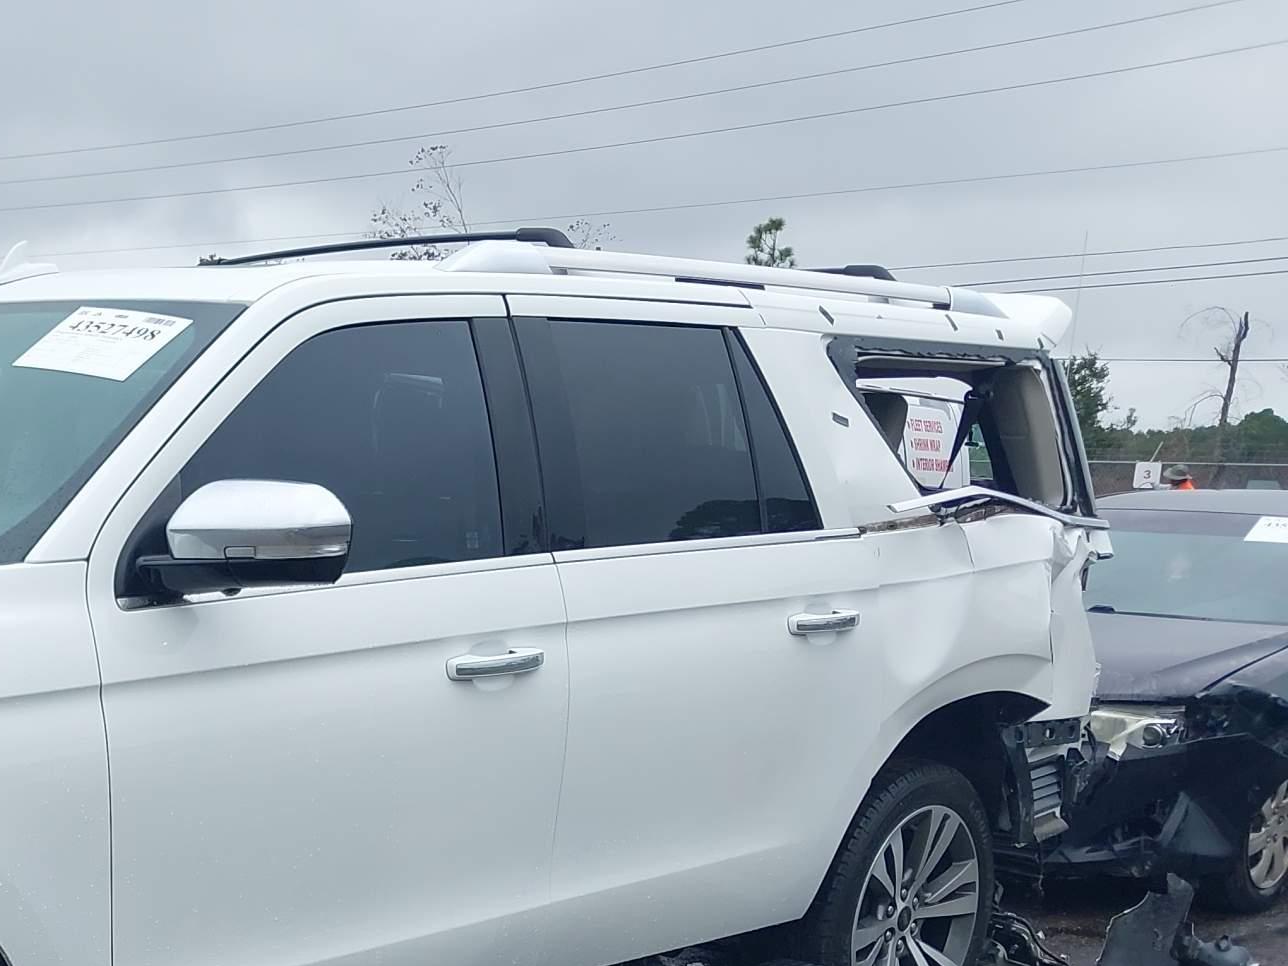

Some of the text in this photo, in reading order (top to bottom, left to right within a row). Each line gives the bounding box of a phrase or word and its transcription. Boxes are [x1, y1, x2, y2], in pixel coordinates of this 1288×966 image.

[69, 319, 161, 341] 43527498
[923, 420, 943, 433] SERVICES
[916, 457, 934, 471] INTERIOR
[1143, 469, 1151, 479] 3
